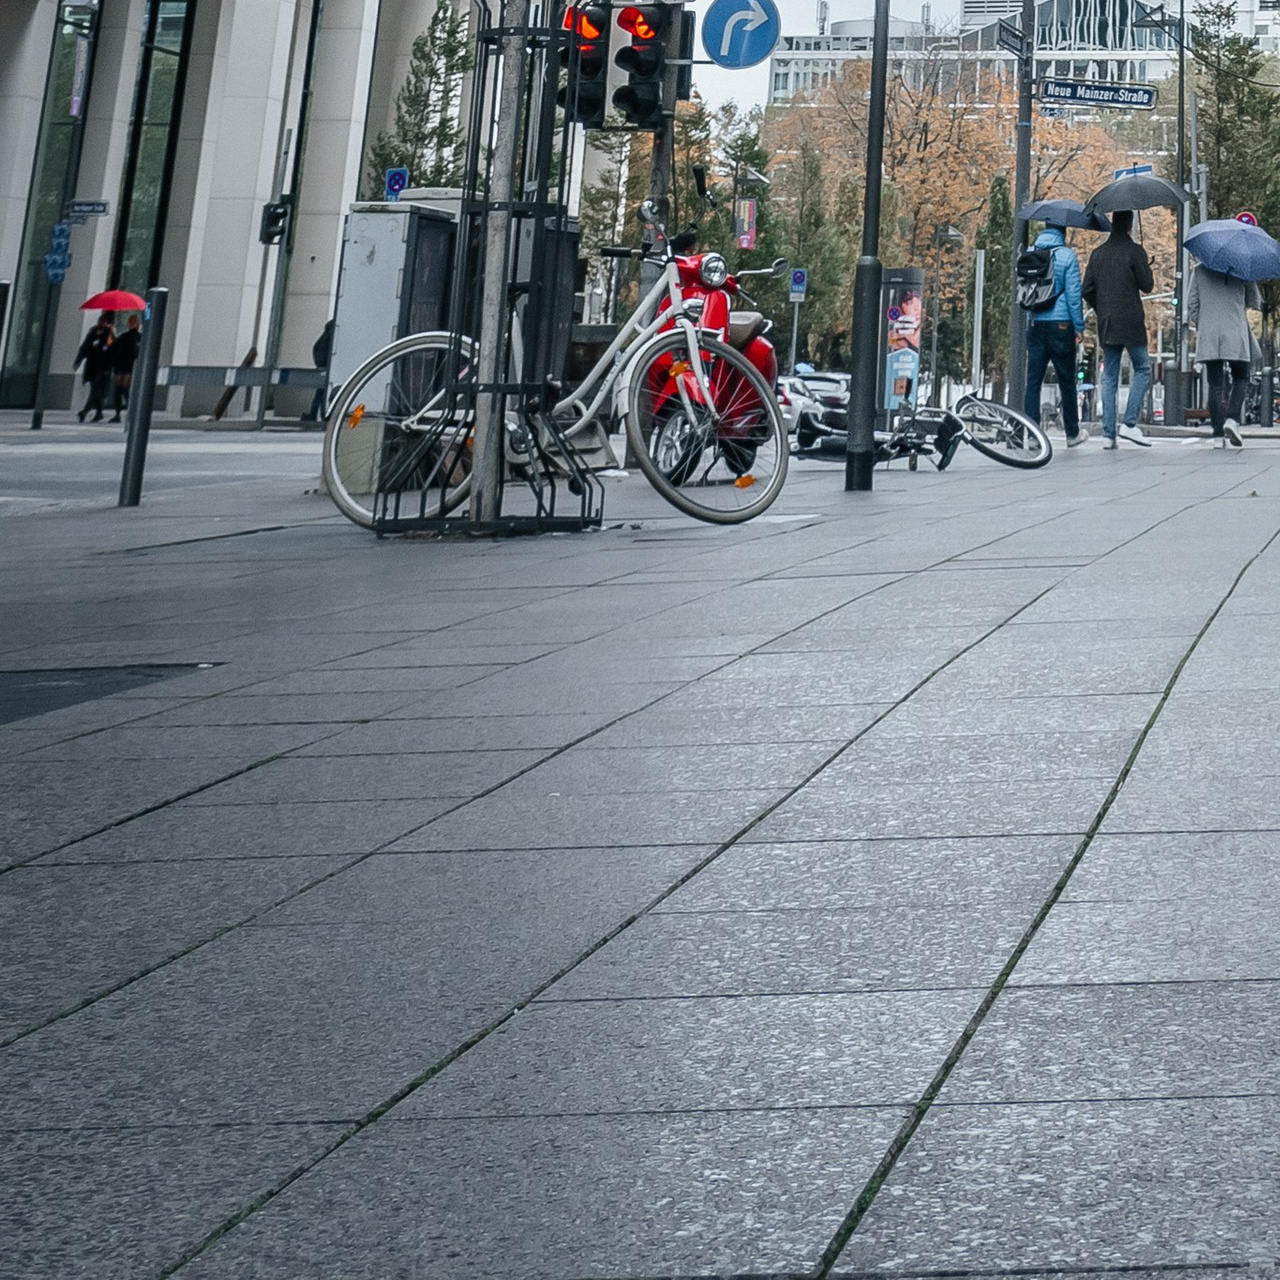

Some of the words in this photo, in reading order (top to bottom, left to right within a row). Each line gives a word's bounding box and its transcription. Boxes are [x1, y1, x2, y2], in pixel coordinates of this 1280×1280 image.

[1047, 83, 1072, 97] Neue
[1076, 85, 1115, 100] Mainzer
[1118, 89, 1149, 103] Straße
